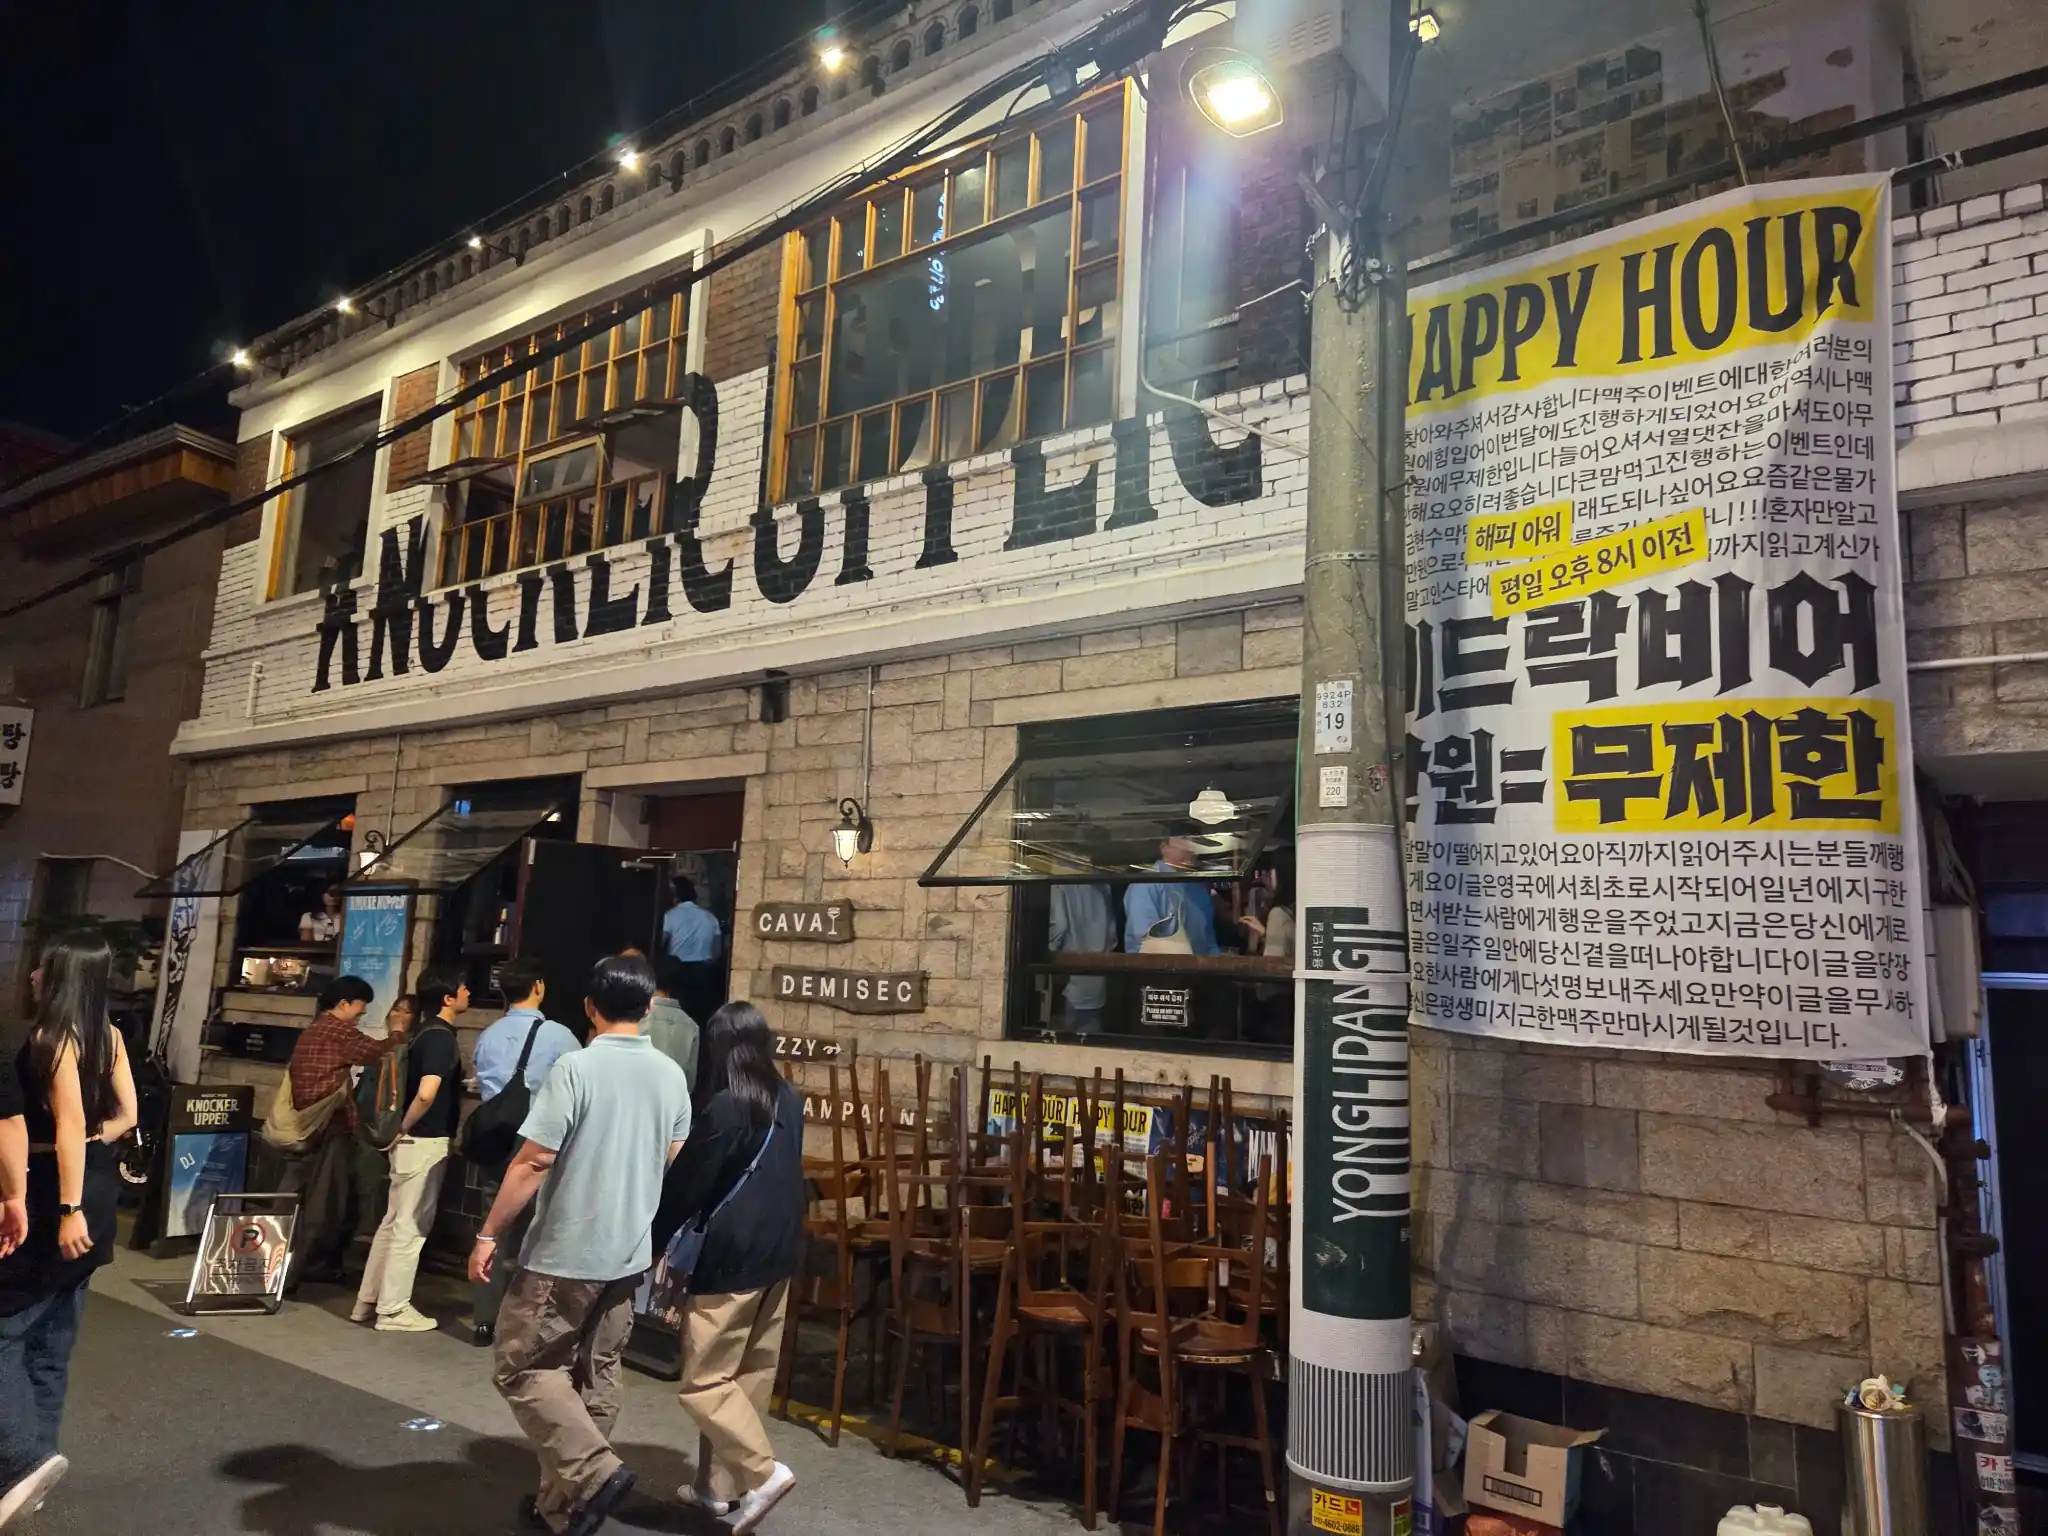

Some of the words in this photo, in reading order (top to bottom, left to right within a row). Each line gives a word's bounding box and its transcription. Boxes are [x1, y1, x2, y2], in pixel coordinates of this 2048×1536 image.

[1617, 205, 1862, 365] HOUR
[1571, 463, 1876, 525] 래도되나싶어요요즘같은물가
[1703, 497, 1878, 527] 니!!!혼자만알고
[1475, 522, 1518, 552] 해피
[1522, 511, 1561, 547] 아워
[1500, 569, 1543, 605] 평일
[1548, 554, 1593, 592] 오후
[1597, 538, 1637, 575] 8시
[1642, 521, 1695, 561] 이전
[1324, 712, 1345, 730] 19
[1562, 705, 1885, 826] 무제한
[1325, 786, 1341, 797] 220
[758, 911, 824, 933] CAVA
[1311, 922, 1325, 969] 용리단길
[781, 974, 913, 1003] DEMISEC
[775, 1036, 817, 1057] ZZY
[1332, 906, 1402, 1222] YONGLIDANGIL
[186, 1098, 240, 1113] KNOCKER
[193, 1112, 230, 1126] UPPER
[803, 1096, 934, 1133] AMPAN
[993, 1093, 1031, 1123] HAPY
[179, 1152, 196, 1171] DJ
[1314, 1493, 1344, 1512] 카드
